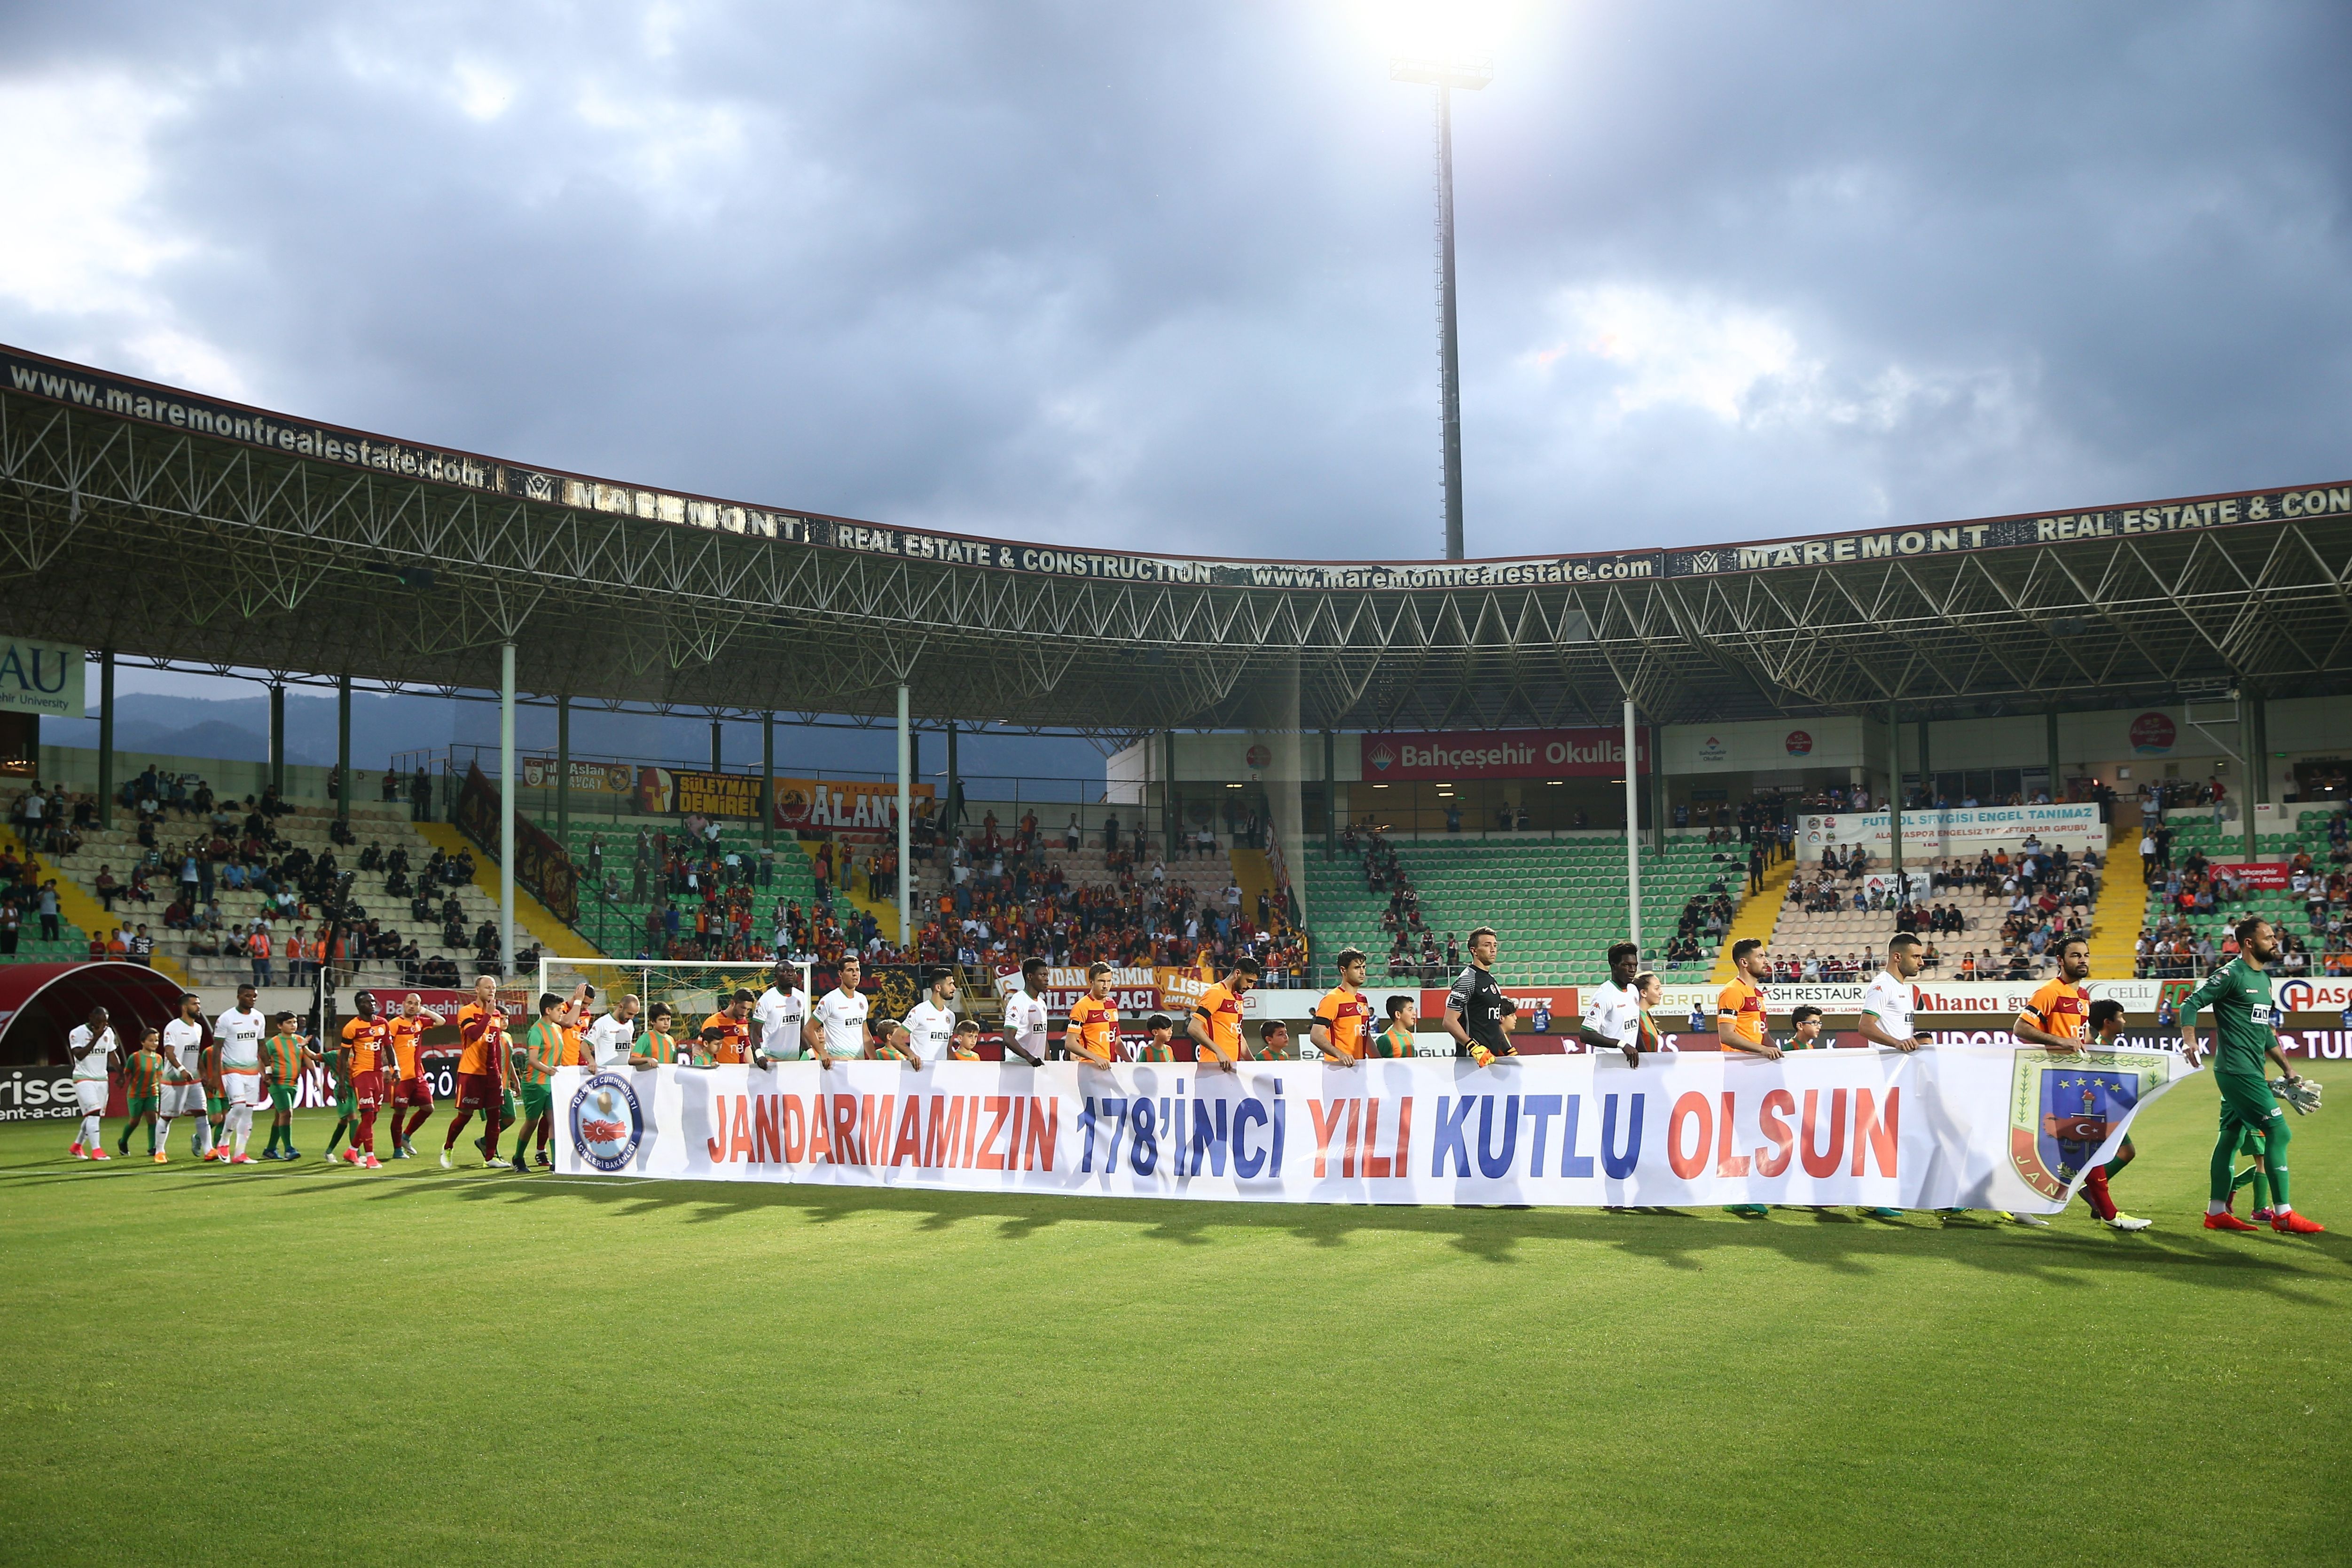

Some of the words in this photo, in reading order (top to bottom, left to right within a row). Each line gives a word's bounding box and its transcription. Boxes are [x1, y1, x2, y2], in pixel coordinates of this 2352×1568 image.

[10, 365, 483, 487] www.maremontrealestate.com
[2038, 514, 2113, 541] REAL
[2124, 500, 2236, 533] ESTATE
[2248, 495, 2271, 520] &
[2282, 487, 2352, 517] CON
[839, 525, 898, 554] REAL
[906, 534, 990, 565] ESTATE
[1001, 546, 1015, 568] &
[1023, 549, 1211, 584] CONSTRUCTION
[1740, 525, 1989, 569] MAREMONT
[1252, 561, 1652, 588] www.maremontrealestate.com
[20, 695, 69, 710] University
[1401, 743, 1536, 769] Bahçeşehir
[1546, 739, 1643, 764] Okullaı
[545, 761, 604, 776] ulAslan
[547, 776, 603, 790] MAAVGAT
[680, 776, 760, 797] SÜLEYMAN
[680, 792, 760, 817] DEMİREL
[1862, 816, 1914, 826] FUTOL
[1919, 811, 1973, 824] SEVGİSİ
[1978, 811, 2023, 822] ENGEL
[2028, 808, 2092, 819] TANIMAZ
[1875, 831, 1934, 839] ALAYASPOR
[1938, 827, 1982, 837] ENGELSİZ
[1985, 825, 2051, 834] TAAFTARLAR
[1884, 876, 1926, 885] Bahehir
[136, 943, 149, 954] 36
[2108, 985, 2154, 998] CELİL
[1163, 996, 1198, 1008] ANTAL
[1662, 994, 1718, 1005] GROU
[2253, 1008, 2268, 1019] TA
[1624, 1018, 1639, 1030] TA
[408, 1034, 420, 1047] nef
[479, 1031, 496, 1043] nef
[1099, 1027, 1116, 1043] nef
[364, 1038, 382, 1051] nef
[730, 1040, 745, 1054] nef
[2113, 1033, 2183, 1055] ÖMLEK
[572, 1079, 598, 1109] TÜRKİYE
[599, 1076, 638, 1110] CUMHURİYETİ
[706, 1093, 1058, 1171] JANDARMAMIZIN
[1077, 1078, 1283, 1179] 178'İNCİ
[1307, 1096, 1413, 1178] YILI
[1431, 1093, 1645, 1179] KUTLU
[1667, 1086, 1900, 1180] OLSUN
[576, 1141, 604, 1168] İÇİŞLERİ
[605, 1140, 636, 1168] BAKANLIĞI
